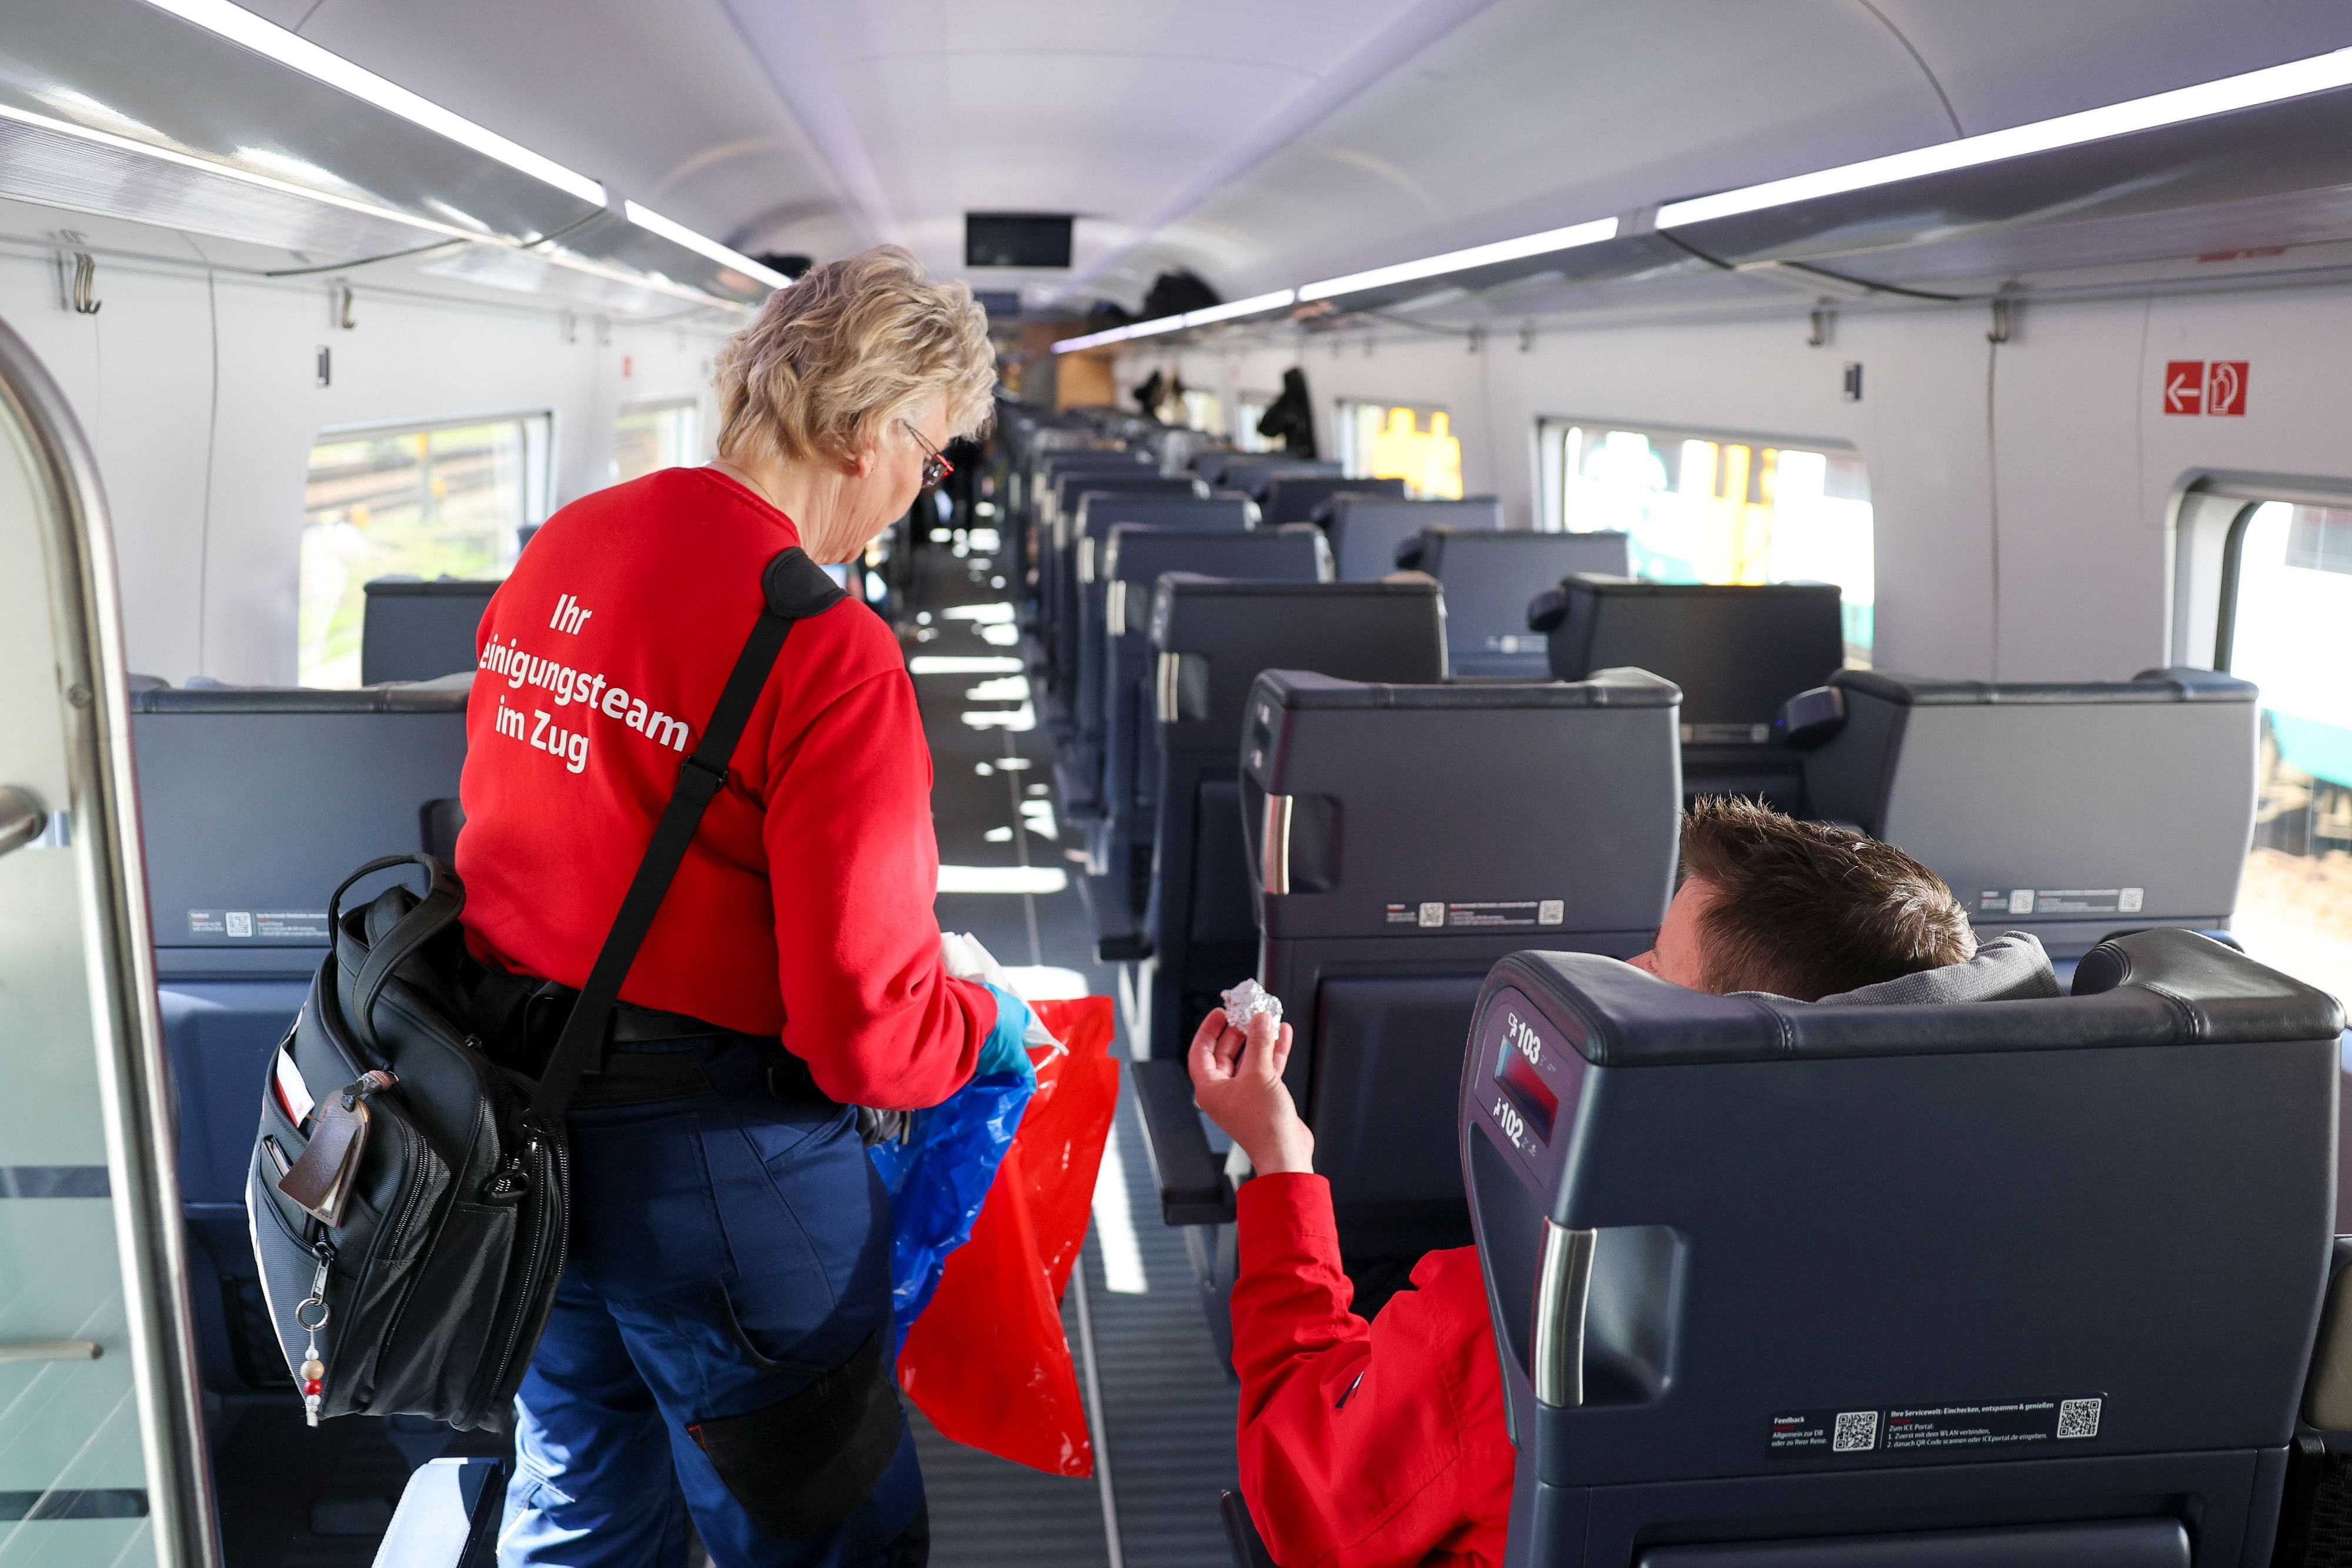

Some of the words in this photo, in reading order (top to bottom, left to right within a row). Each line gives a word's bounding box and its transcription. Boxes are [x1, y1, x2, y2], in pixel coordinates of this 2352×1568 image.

[549, 593, 593, 636] Ihr
[479, 633, 689, 753] einigungsteam
[495, 694, 525, 741] im
[530, 708, 589, 774] Zug
[1518, 1021, 1541, 1065] 103
[1501, 1102, 1524, 1148] 102
[2025, 1402, 2054, 1410] genießen
